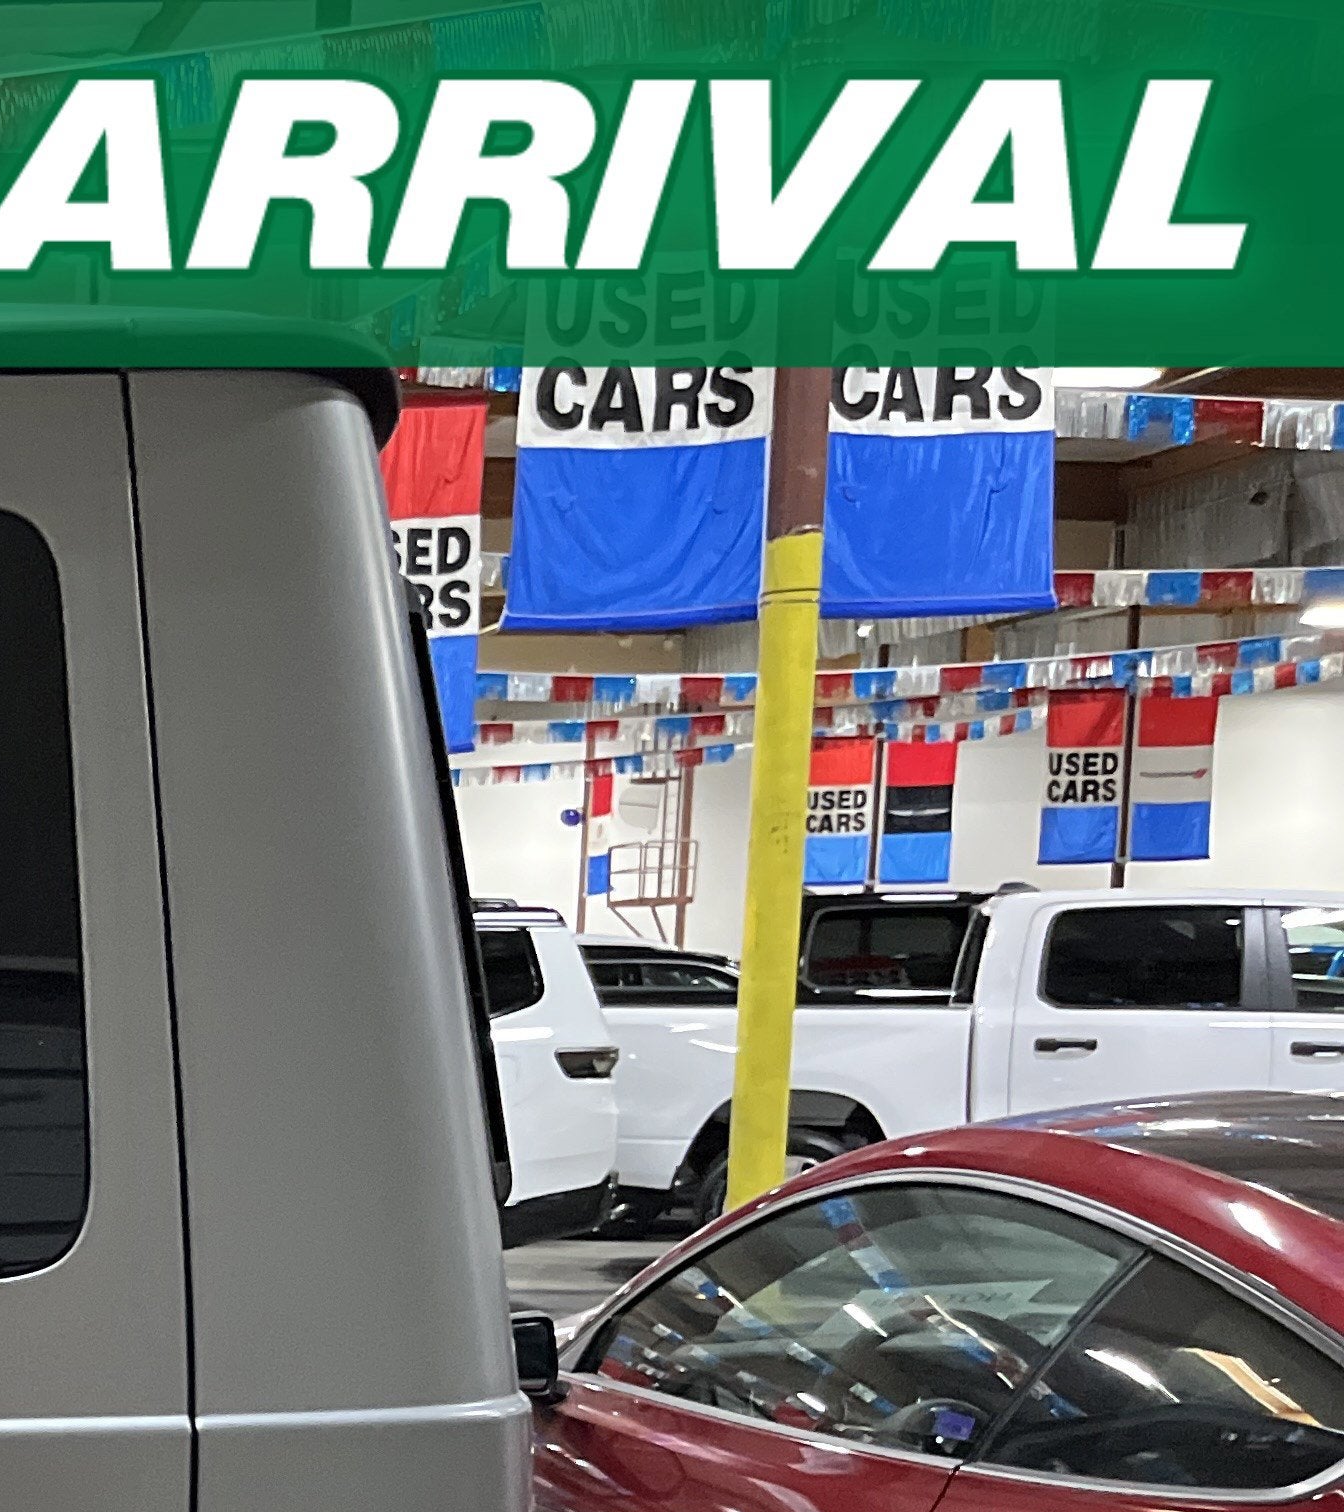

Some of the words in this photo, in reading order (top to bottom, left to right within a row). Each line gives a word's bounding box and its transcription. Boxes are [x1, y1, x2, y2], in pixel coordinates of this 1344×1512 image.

[536, 351, 755, 433] CARS
[831, 343, 1042, 422] CARS
[1048, 752, 1119, 776] USED
[807, 790, 868, 810] USED
[1046, 778, 1117, 802] CARS
[805, 811, 866, 833] CARS
